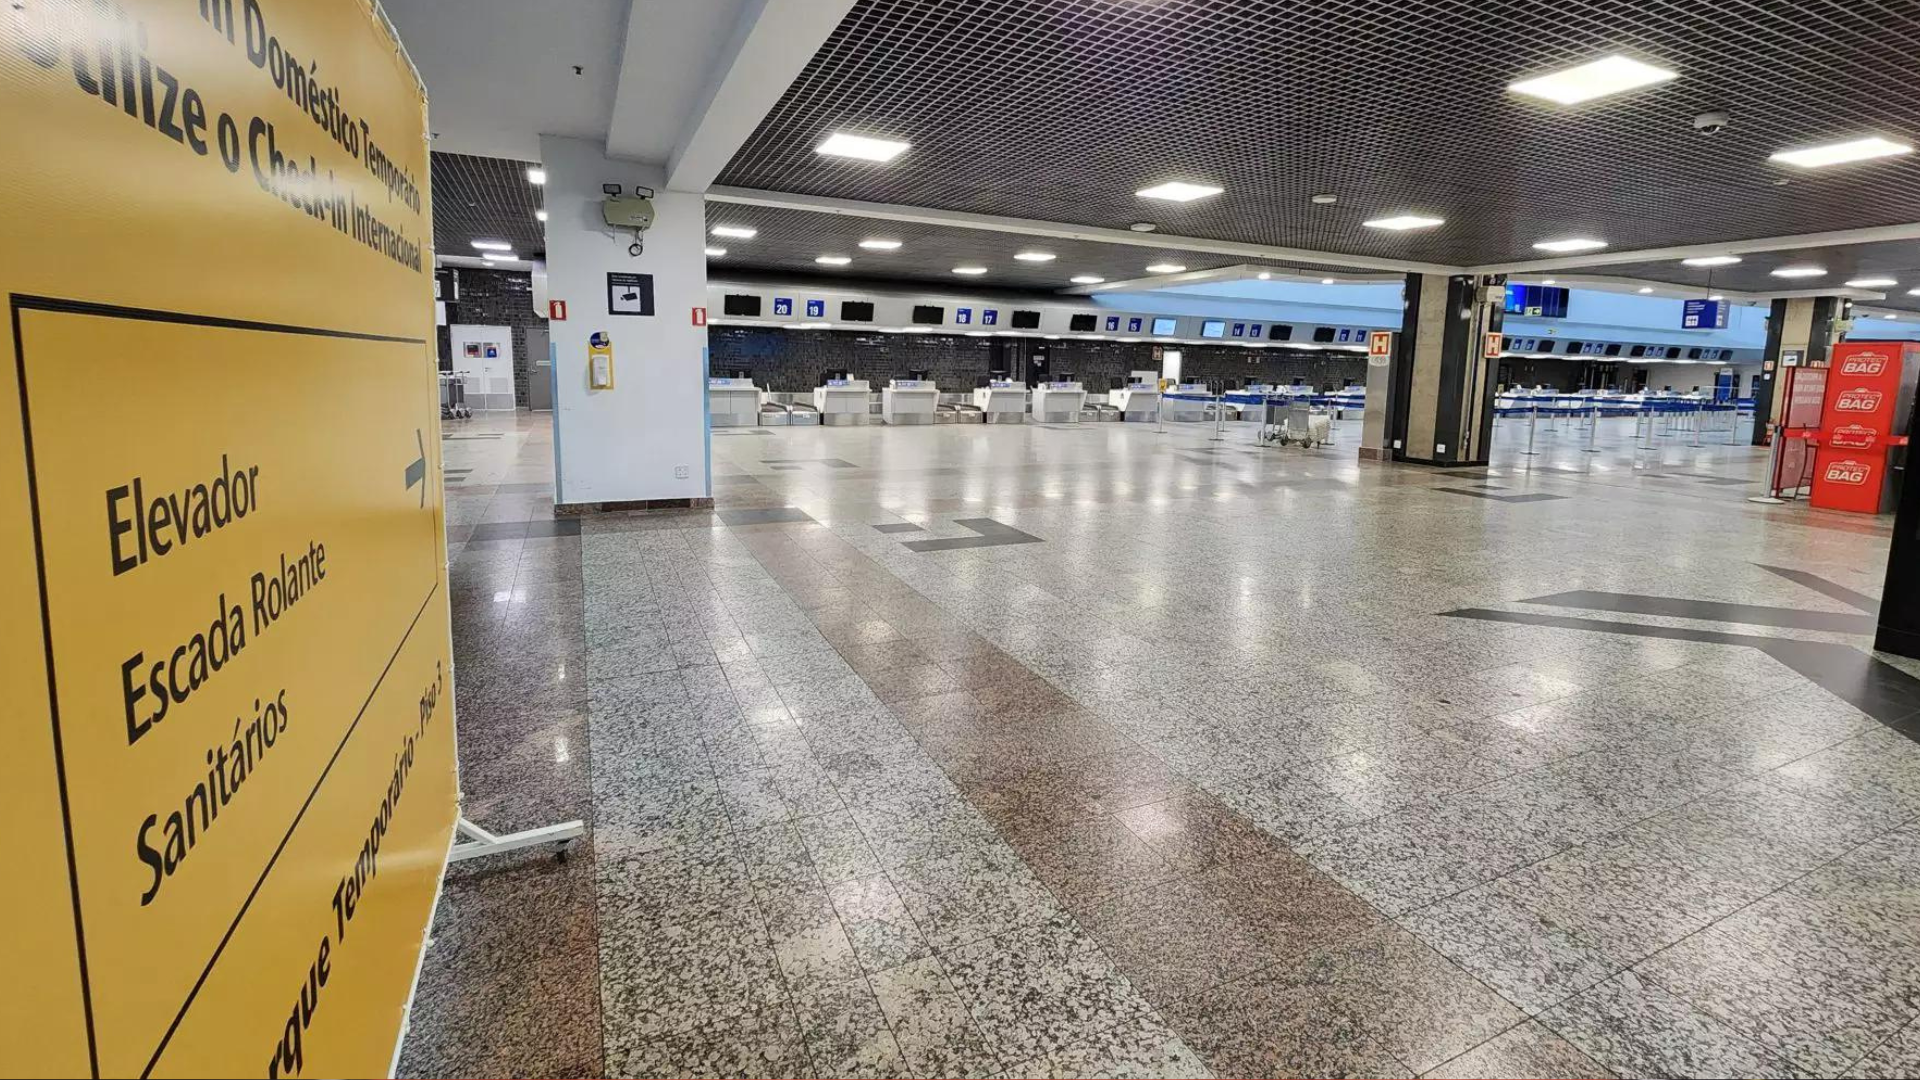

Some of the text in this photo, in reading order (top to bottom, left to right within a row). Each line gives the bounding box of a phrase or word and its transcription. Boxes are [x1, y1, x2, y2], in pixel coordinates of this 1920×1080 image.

[244, 0, 421, 216] Doméstico Temporário
[20, 10, 209, 156] tilize
[217, 113, 240, 173] o
[350, 188, 422, 273] Internacional
[776, 304, 788, 315] 20
[809, 305, 819, 316] 19
[958, 313, 967, 323] 18
[984, 315, 993, 324] 17
[1843, 362, 1881, 373] BAG
[1838, 398, 1875, 409] BAG
[1827, 469, 1863, 481] BAG
[106, 453, 259, 576] Elevador
[121, 540, 326, 746] Escada Rolante
[137, 688, 288, 907] Sanitários
[332, 735, 414, 945] Temporário
[420, 683, 436, 738] Piso
[437, 660, 442, 695] 3
